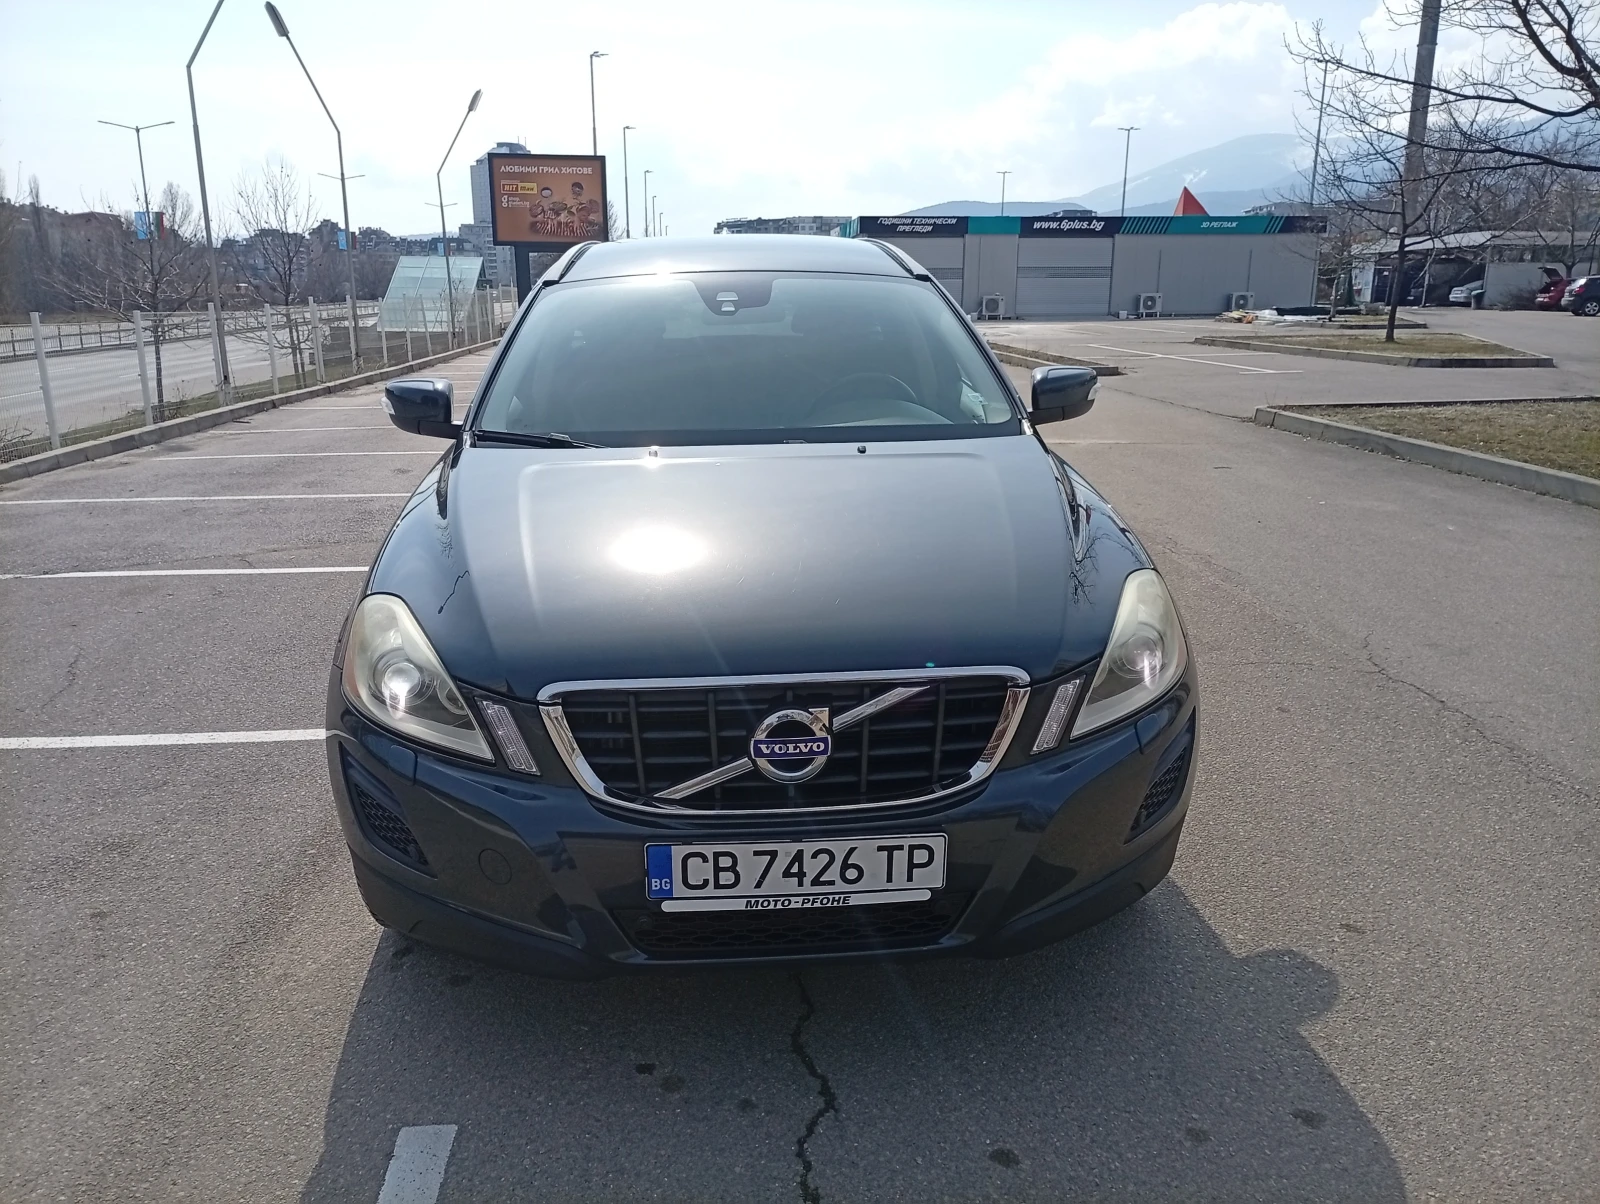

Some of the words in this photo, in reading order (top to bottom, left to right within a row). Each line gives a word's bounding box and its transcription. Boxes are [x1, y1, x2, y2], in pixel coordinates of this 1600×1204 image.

[500, 165, 538, 173] ЛЮБИМИ
[1033, 219, 1105, 231] www.6plus.bg
[758, 742, 825, 754] VOLVO
[651, 879, 671, 890] BG
[680, 851, 741, 890] CB
[753, 846, 865, 889] 7426
[877, 843, 936, 883] TP
[744, 896, 852, 909] MOTO-PFOHE
